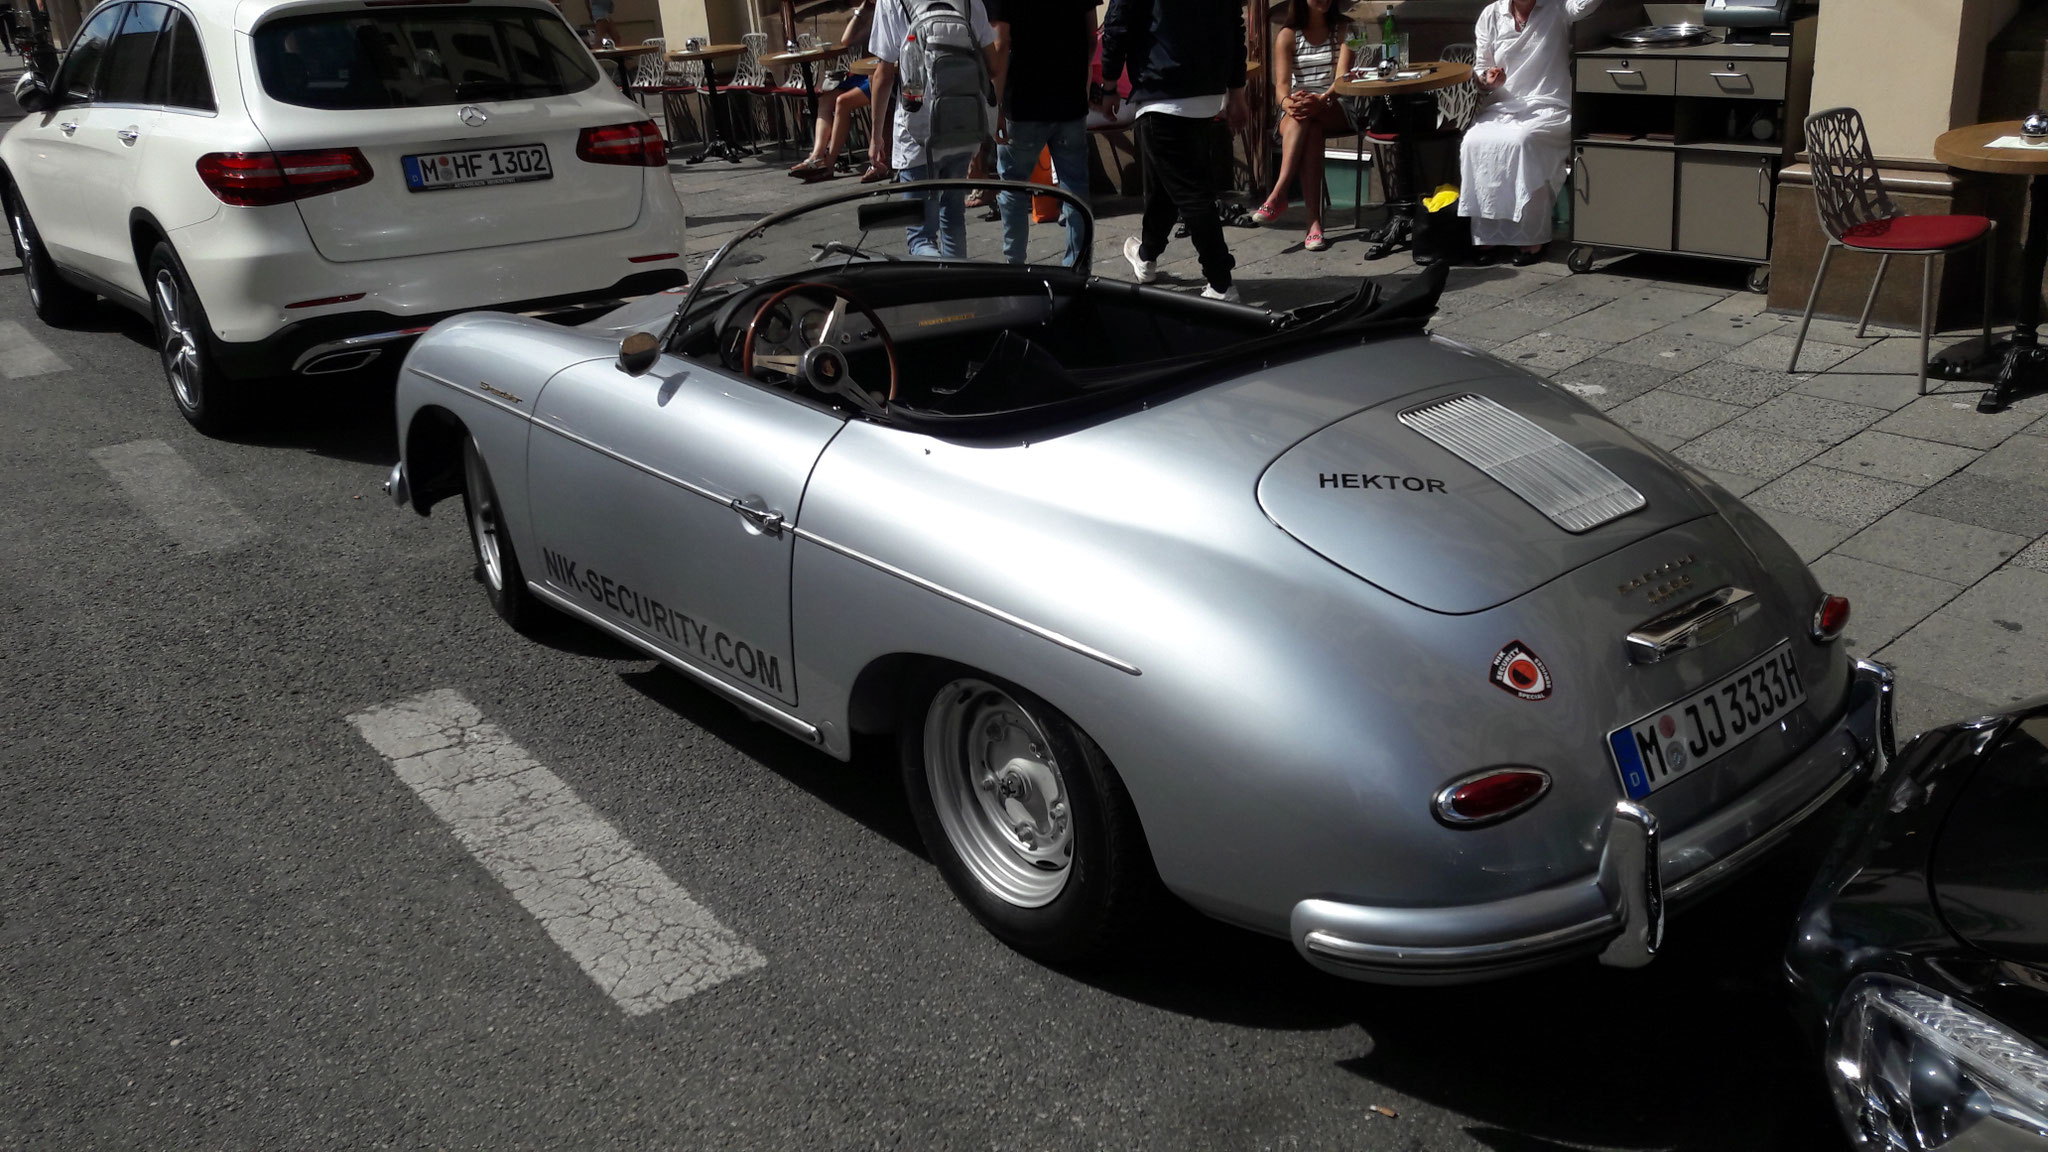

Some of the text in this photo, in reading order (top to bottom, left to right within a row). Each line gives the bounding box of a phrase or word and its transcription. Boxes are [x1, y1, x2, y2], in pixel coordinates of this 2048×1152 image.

[421, 150, 547, 182] M HF 1302
[1319, 473, 1448, 494] HEKTOR
[543, 547, 783, 693] NIK-SECURITY.COM
[1493, 651, 1506, 666] NIK
[1496, 647, 1520, 681] SECURITY
[1636, 648, 1805, 783] M JJ 3333H
[1629, 771, 1641, 787] D
